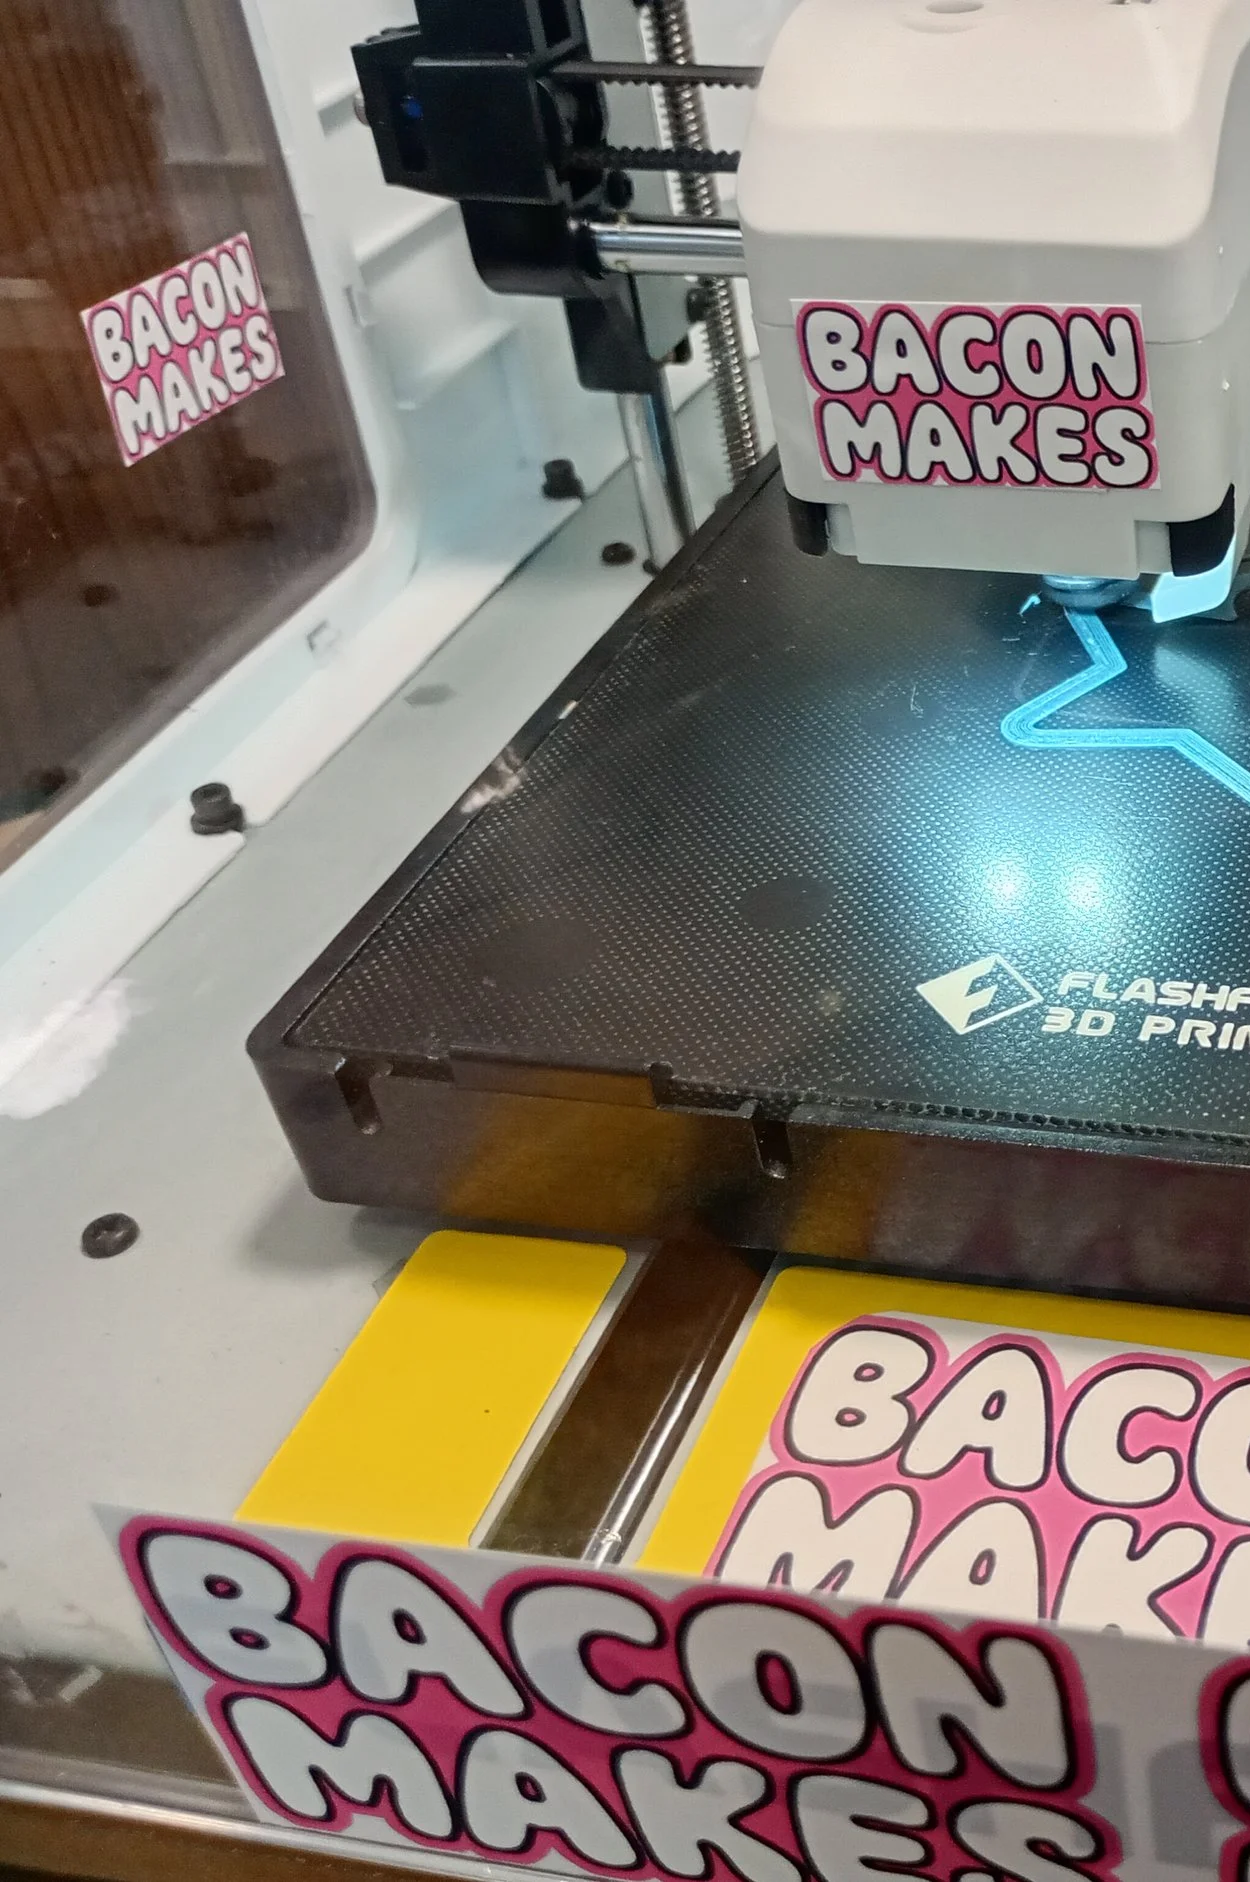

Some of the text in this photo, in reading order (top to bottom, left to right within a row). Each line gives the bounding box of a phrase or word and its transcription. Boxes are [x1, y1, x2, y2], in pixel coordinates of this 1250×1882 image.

[91, 244, 260, 383] BACON
[803, 307, 1142, 400] BACON
[112, 314, 278, 457] MAKES
[820, 399, 1153, 488] MAKES
[1041, 1007, 1116, 1037] 3D
[136, 1530, 1074, 1790] BACON
